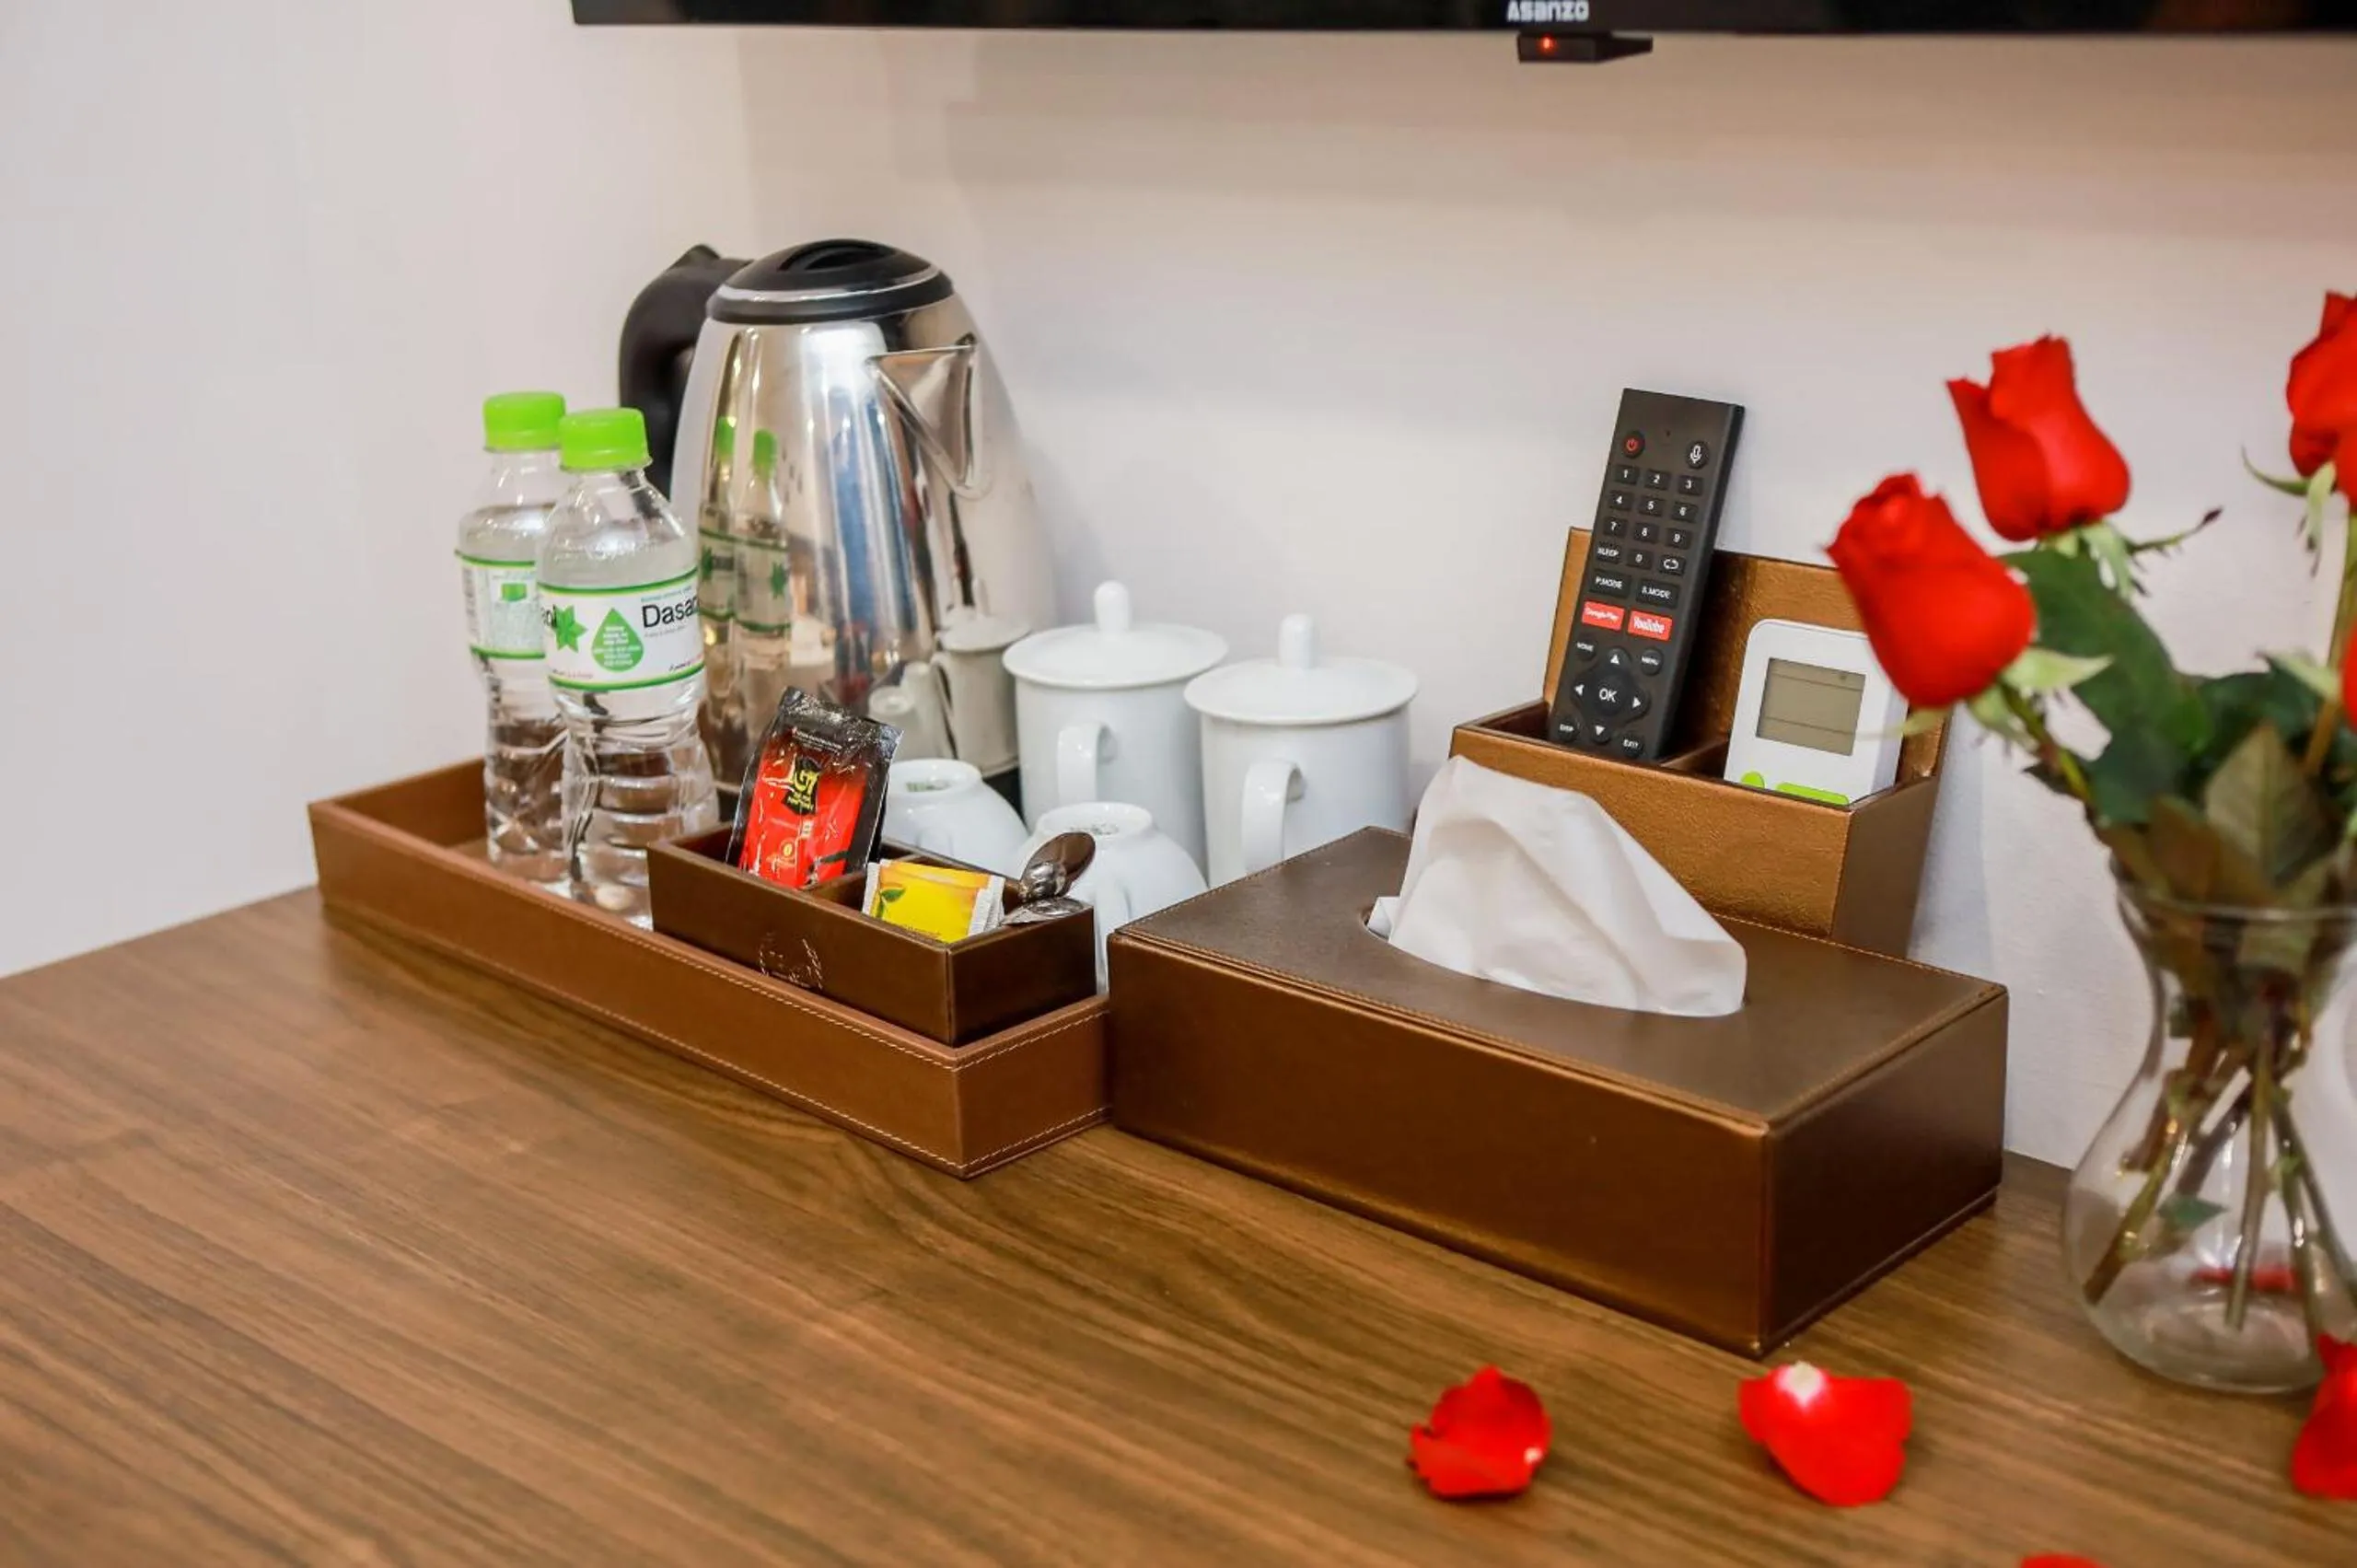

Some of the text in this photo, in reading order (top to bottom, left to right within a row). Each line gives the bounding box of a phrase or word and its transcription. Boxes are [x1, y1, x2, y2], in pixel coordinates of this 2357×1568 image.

[1653, 473, 1660, 484] 2
[1685, 479, 1692, 490] 3
[1647, 500, 1655, 511] 5
[1678, 506, 1687, 517] 6
[1641, 527, 1648, 537] 8
[1672, 533, 1680, 543] 9
[1598, 687, 1618, 703] OK
